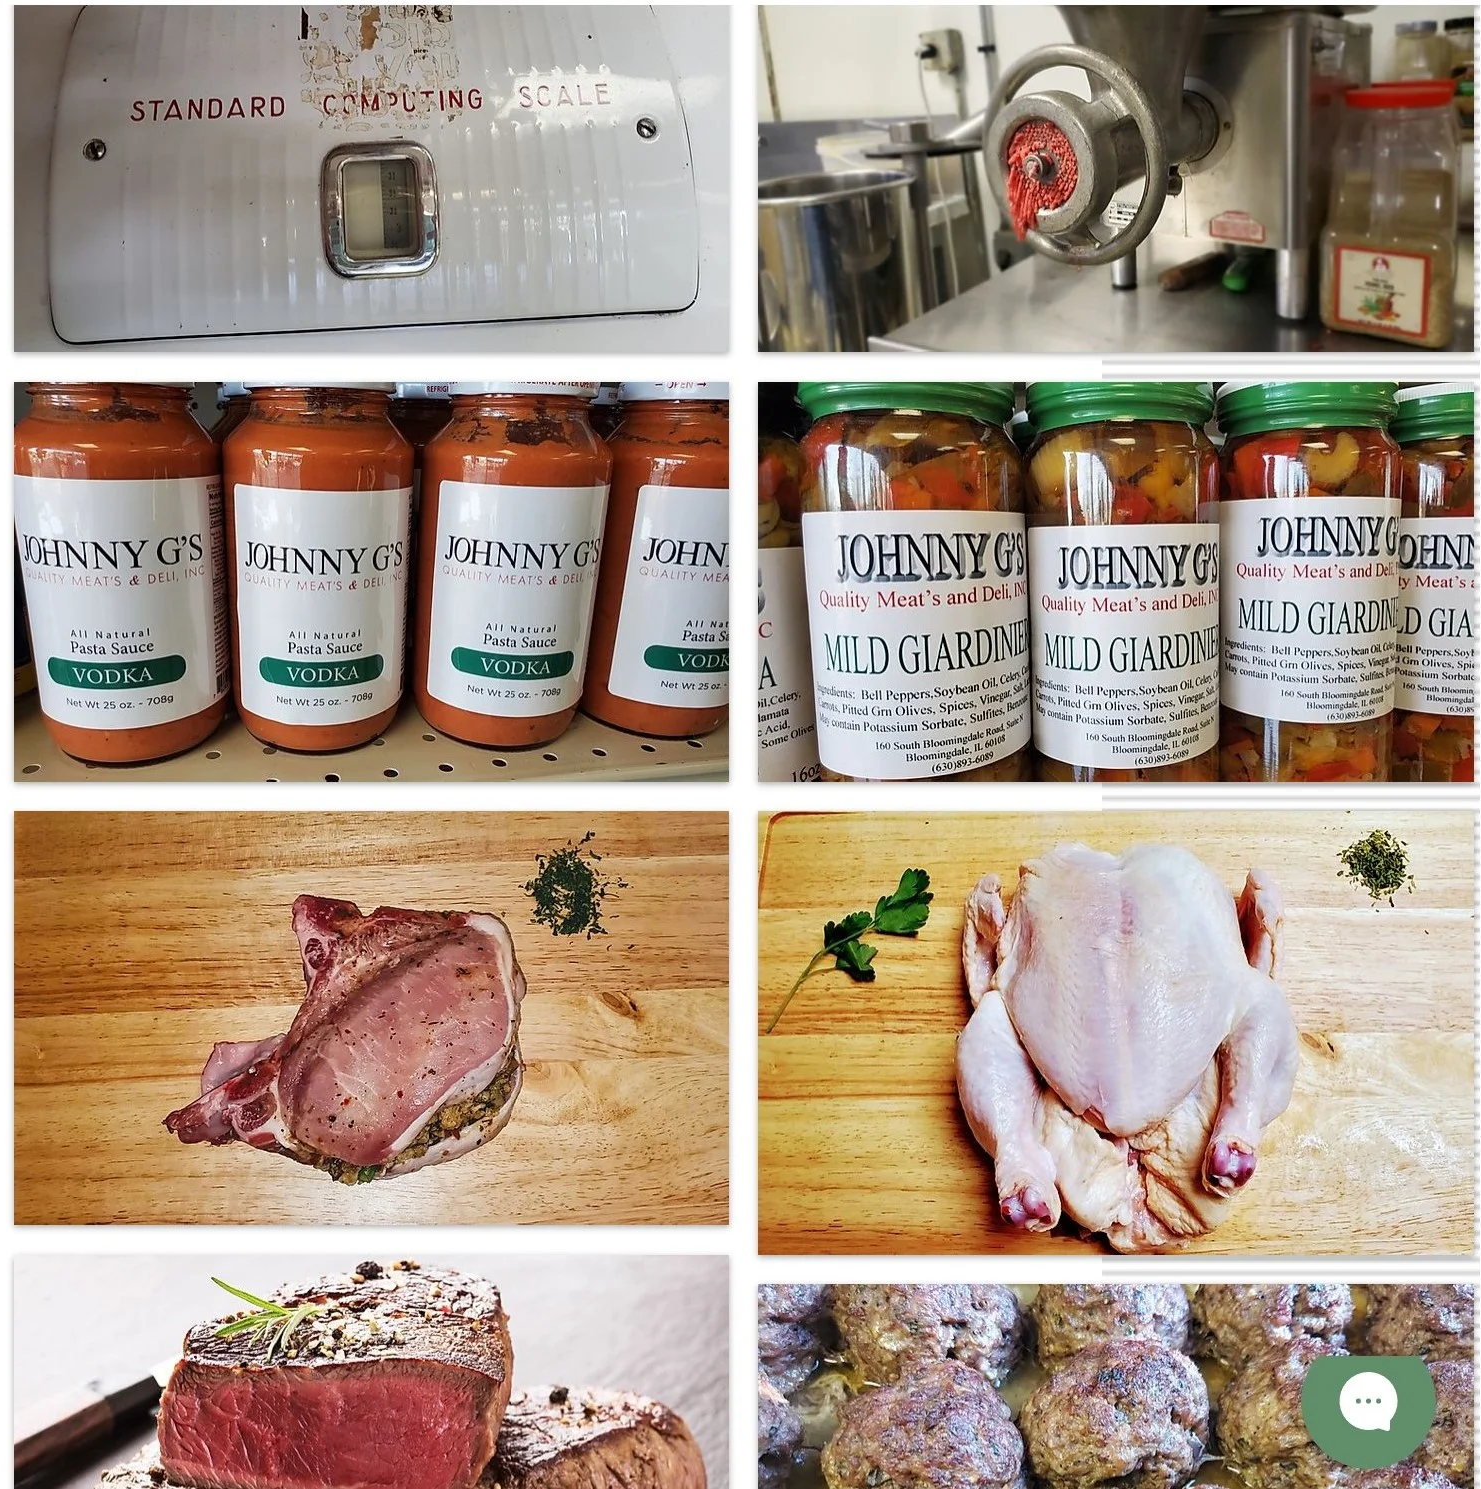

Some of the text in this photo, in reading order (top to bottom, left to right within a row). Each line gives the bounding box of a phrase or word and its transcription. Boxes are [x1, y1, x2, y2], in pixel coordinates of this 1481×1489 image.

[130, 83, 611, 123] STANDARD COMPUTING SCALE
[1257, 515, 1384, 557] JOHNNY
[23, 533, 203, 570] JOHNNY G'S
[245, 541, 403, 576] JOHNNY G'S
[444, 535, 601, 570] JOHNNY G'S
[642, 537, 729, 568] JOHN
[836, 531, 1026, 583] JOHNNY G'S
[25, 565, 205, 587] QUALITY MEAT'S & DELI, INC
[1057, 541, 1218, 590] JOHNNY G'S
[1236, 562, 1373, 582] Quality Meat's and
[1415, 575, 1466, 589] Meat's
[819, 589, 870, 613] Quality
[877, 589, 941, 608] Meat's
[947, 587, 978, 605] and
[982, 585, 1012, 603] Deli,
[1041, 590, 1207, 616] Quality Meat's and Deli,
[1238, 598, 1300, 634] MILD
[70, 628, 150, 639] All Natural
[483, 633, 557, 648] Pasta Sauce
[682, 630, 716, 642] Pasta
[70, 641, 154, 655] Pasta Sauce
[288, 641, 363, 655] Pasta Sauce
[824, 632, 890, 675] MILD
[1045, 632, 1101, 672] MILD
[72, 667, 154, 685] VODKA
[286, 666, 359, 682] VODKA
[481, 657, 551, 675] VODKA
[1394, 667, 1439, 680] Potassium
[276, 692, 373, 707] Net Wt 25 oz. 708g
[861, 689, 882, 700] Bell
[982, 676, 998, 690] Oil,
[66, 697, 82, 708] Net
[85, 701, 100, 709] Wt
[103, 701, 117, 709] 25
[146, 695, 174, 706] 708g
[842, 703, 868, 716] Pitted
[871, 705, 892, 717] Grn
[895, 704, 936, 716] Olives,
[939, 700, 977, 715] Spices,
[979, 689, 1012, 705] Vinegar,
[765, 719, 791, 736] Acid,
[831, 719, 860, 732] contain
[863, 721, 918, 733] Potassium
[922, 718, 967, 731] Sorbate,
[970, 708, 1005, 724] Sulfites,
[761, 723, 814, 749] Some Olives
[875, 741, 891, 750] 160
[893, 740, 921, 751] South
[923, 730, 984, 749] Bloomingdale
[986, 723, 1006, 737] Road,
[906, 745, 973, 762] Bloomingdale,
[985, 734, 1006, 748] 60108
[931, 751, 994, 774] (630)893-6089
[1134, 749, 1190, 766] (630)893-6089
